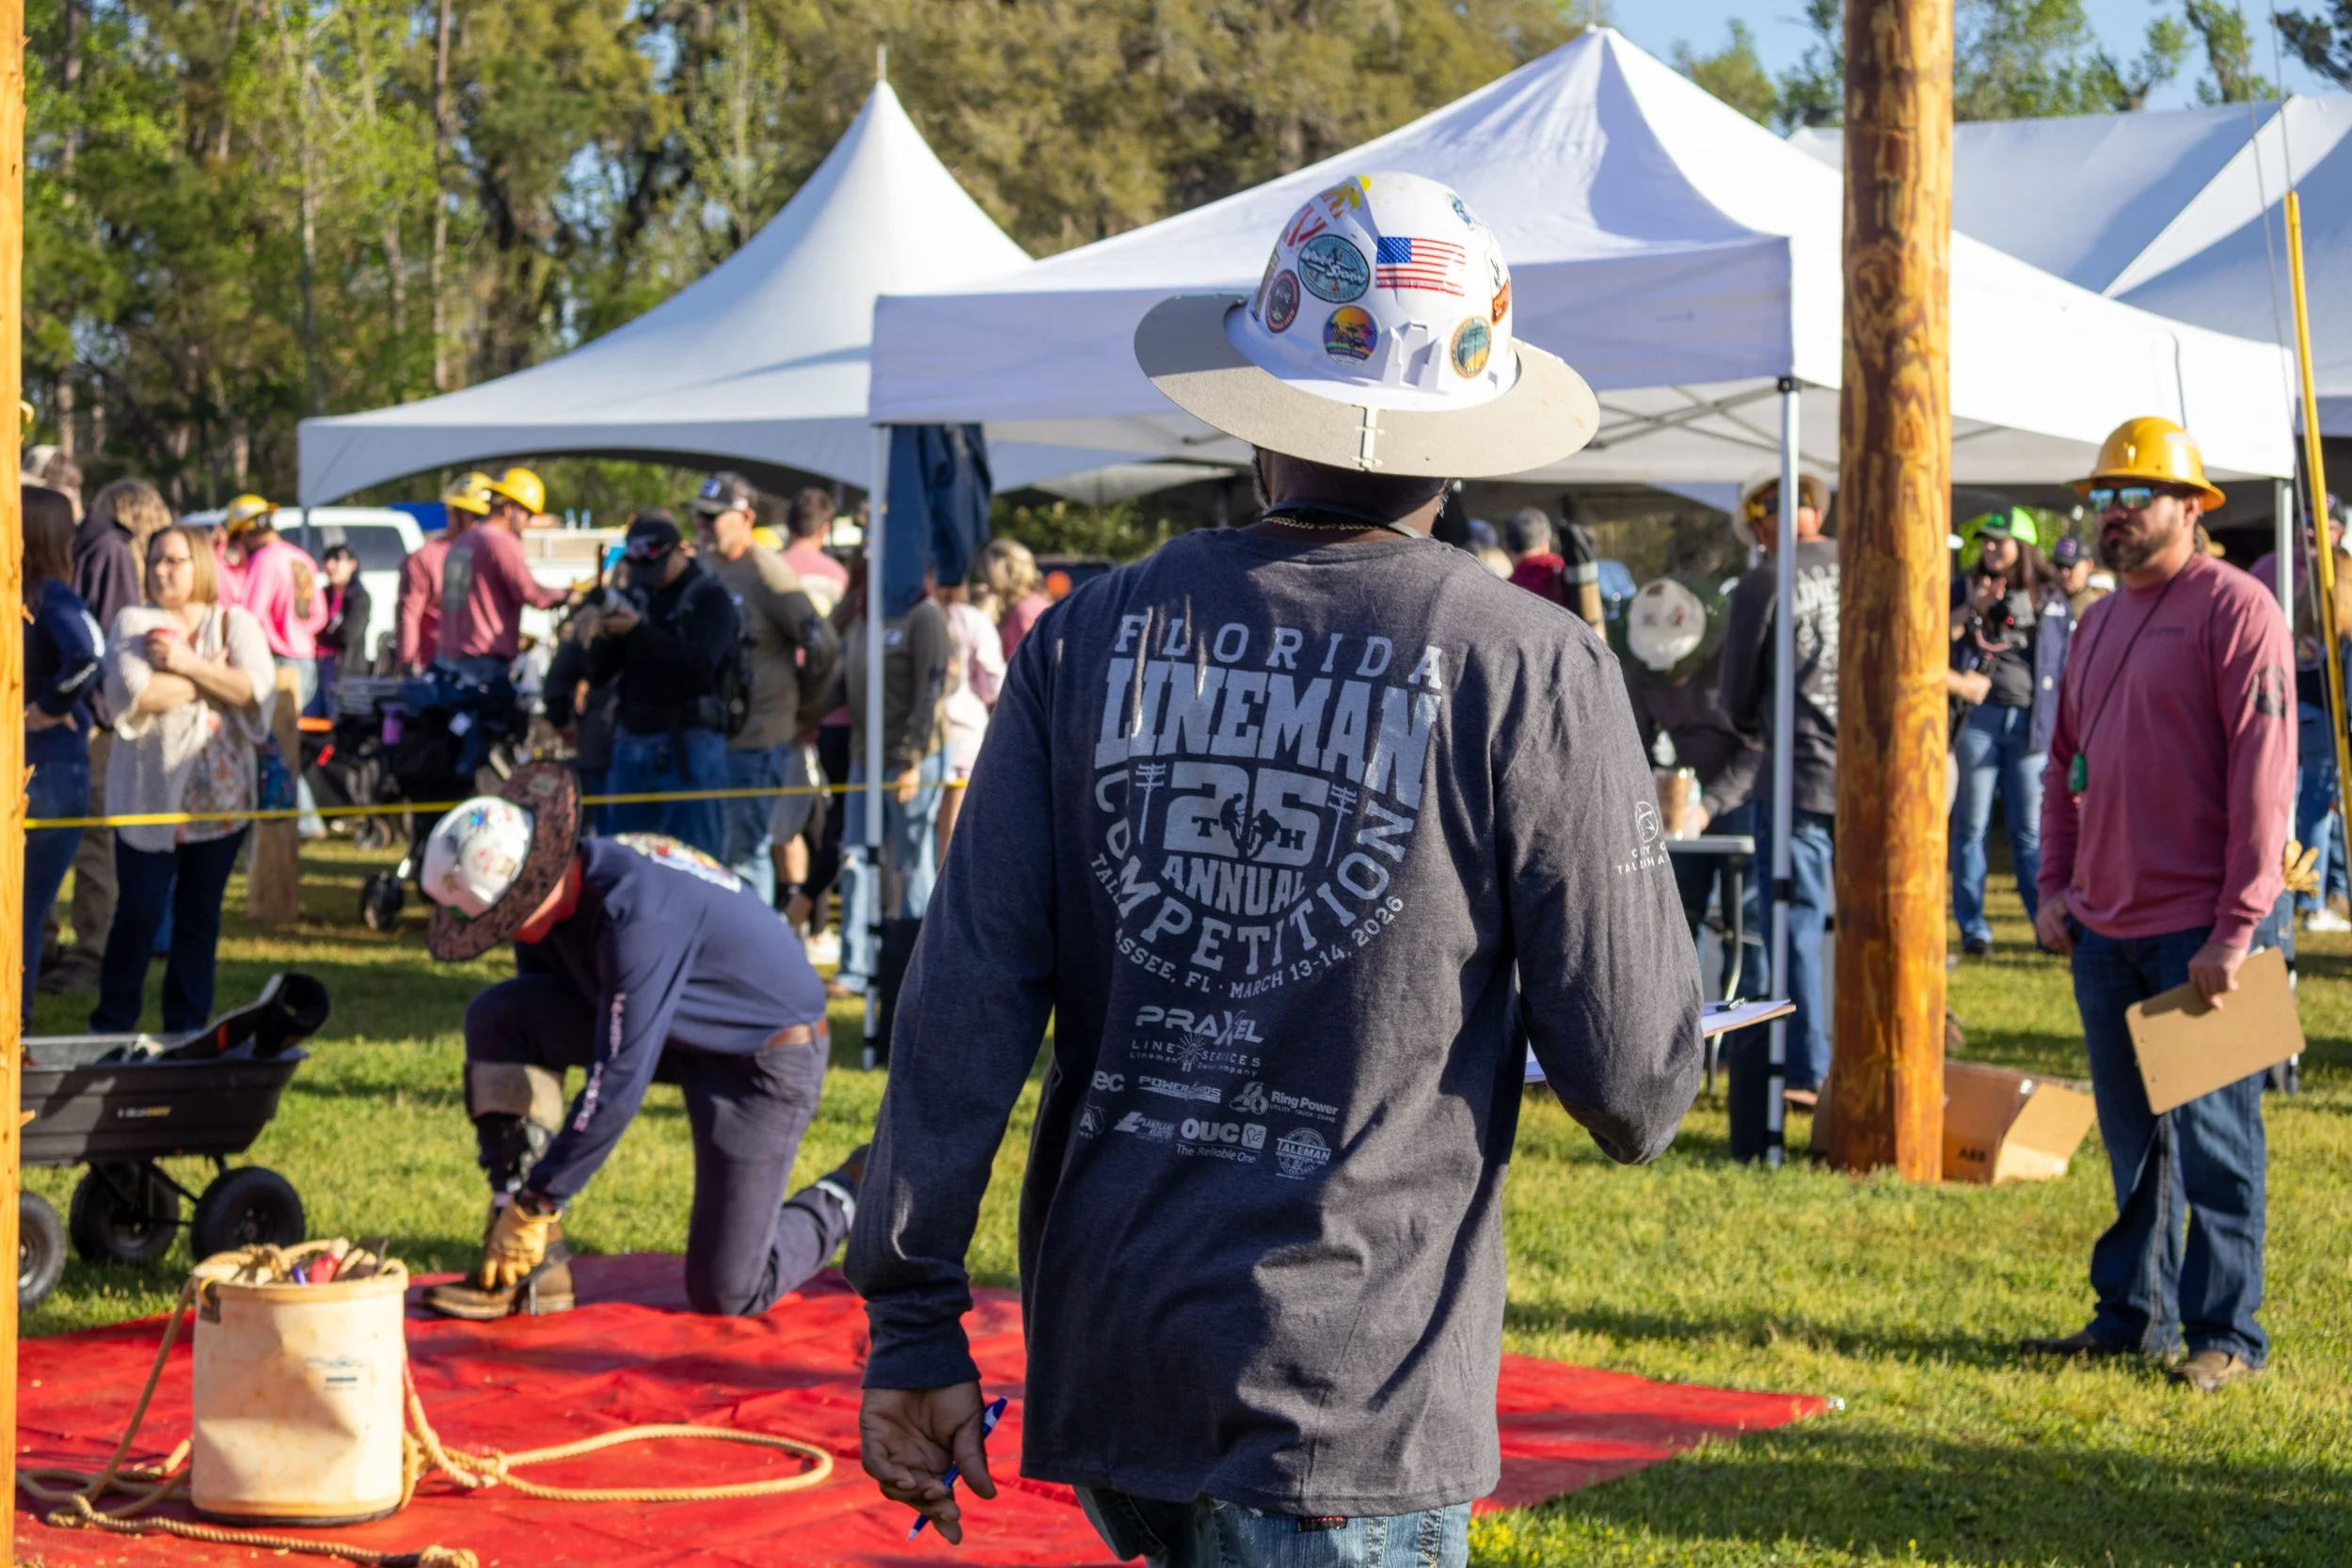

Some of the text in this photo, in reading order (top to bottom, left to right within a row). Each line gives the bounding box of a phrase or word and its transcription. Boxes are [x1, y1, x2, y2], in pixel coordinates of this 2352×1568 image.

[1114, 613, 1442, 690] FLORIDA
[1094, 657, 1442, 811] LINEMAN
[1163, 761, 1331, 866] 25
[1094, 768, 1415, 975] COMPETITION
[1160, 854, 1306, 916] ANNUAL
[1184, 971, 1212, 993] FL
[1230, 970, 1284, 1000] MARCH
[1351, 895, 1404, 948] 2026
[1132, 1039, 1176, 1054] LINE
[1181, 1117, 1240, 1144] OUC
[1271, 1090, 1340, 1116] Ring Power
[1176, 1143, 1257, 1164] The Reliable One
[1276, 1137, 1332, 1163] TALLMAN
